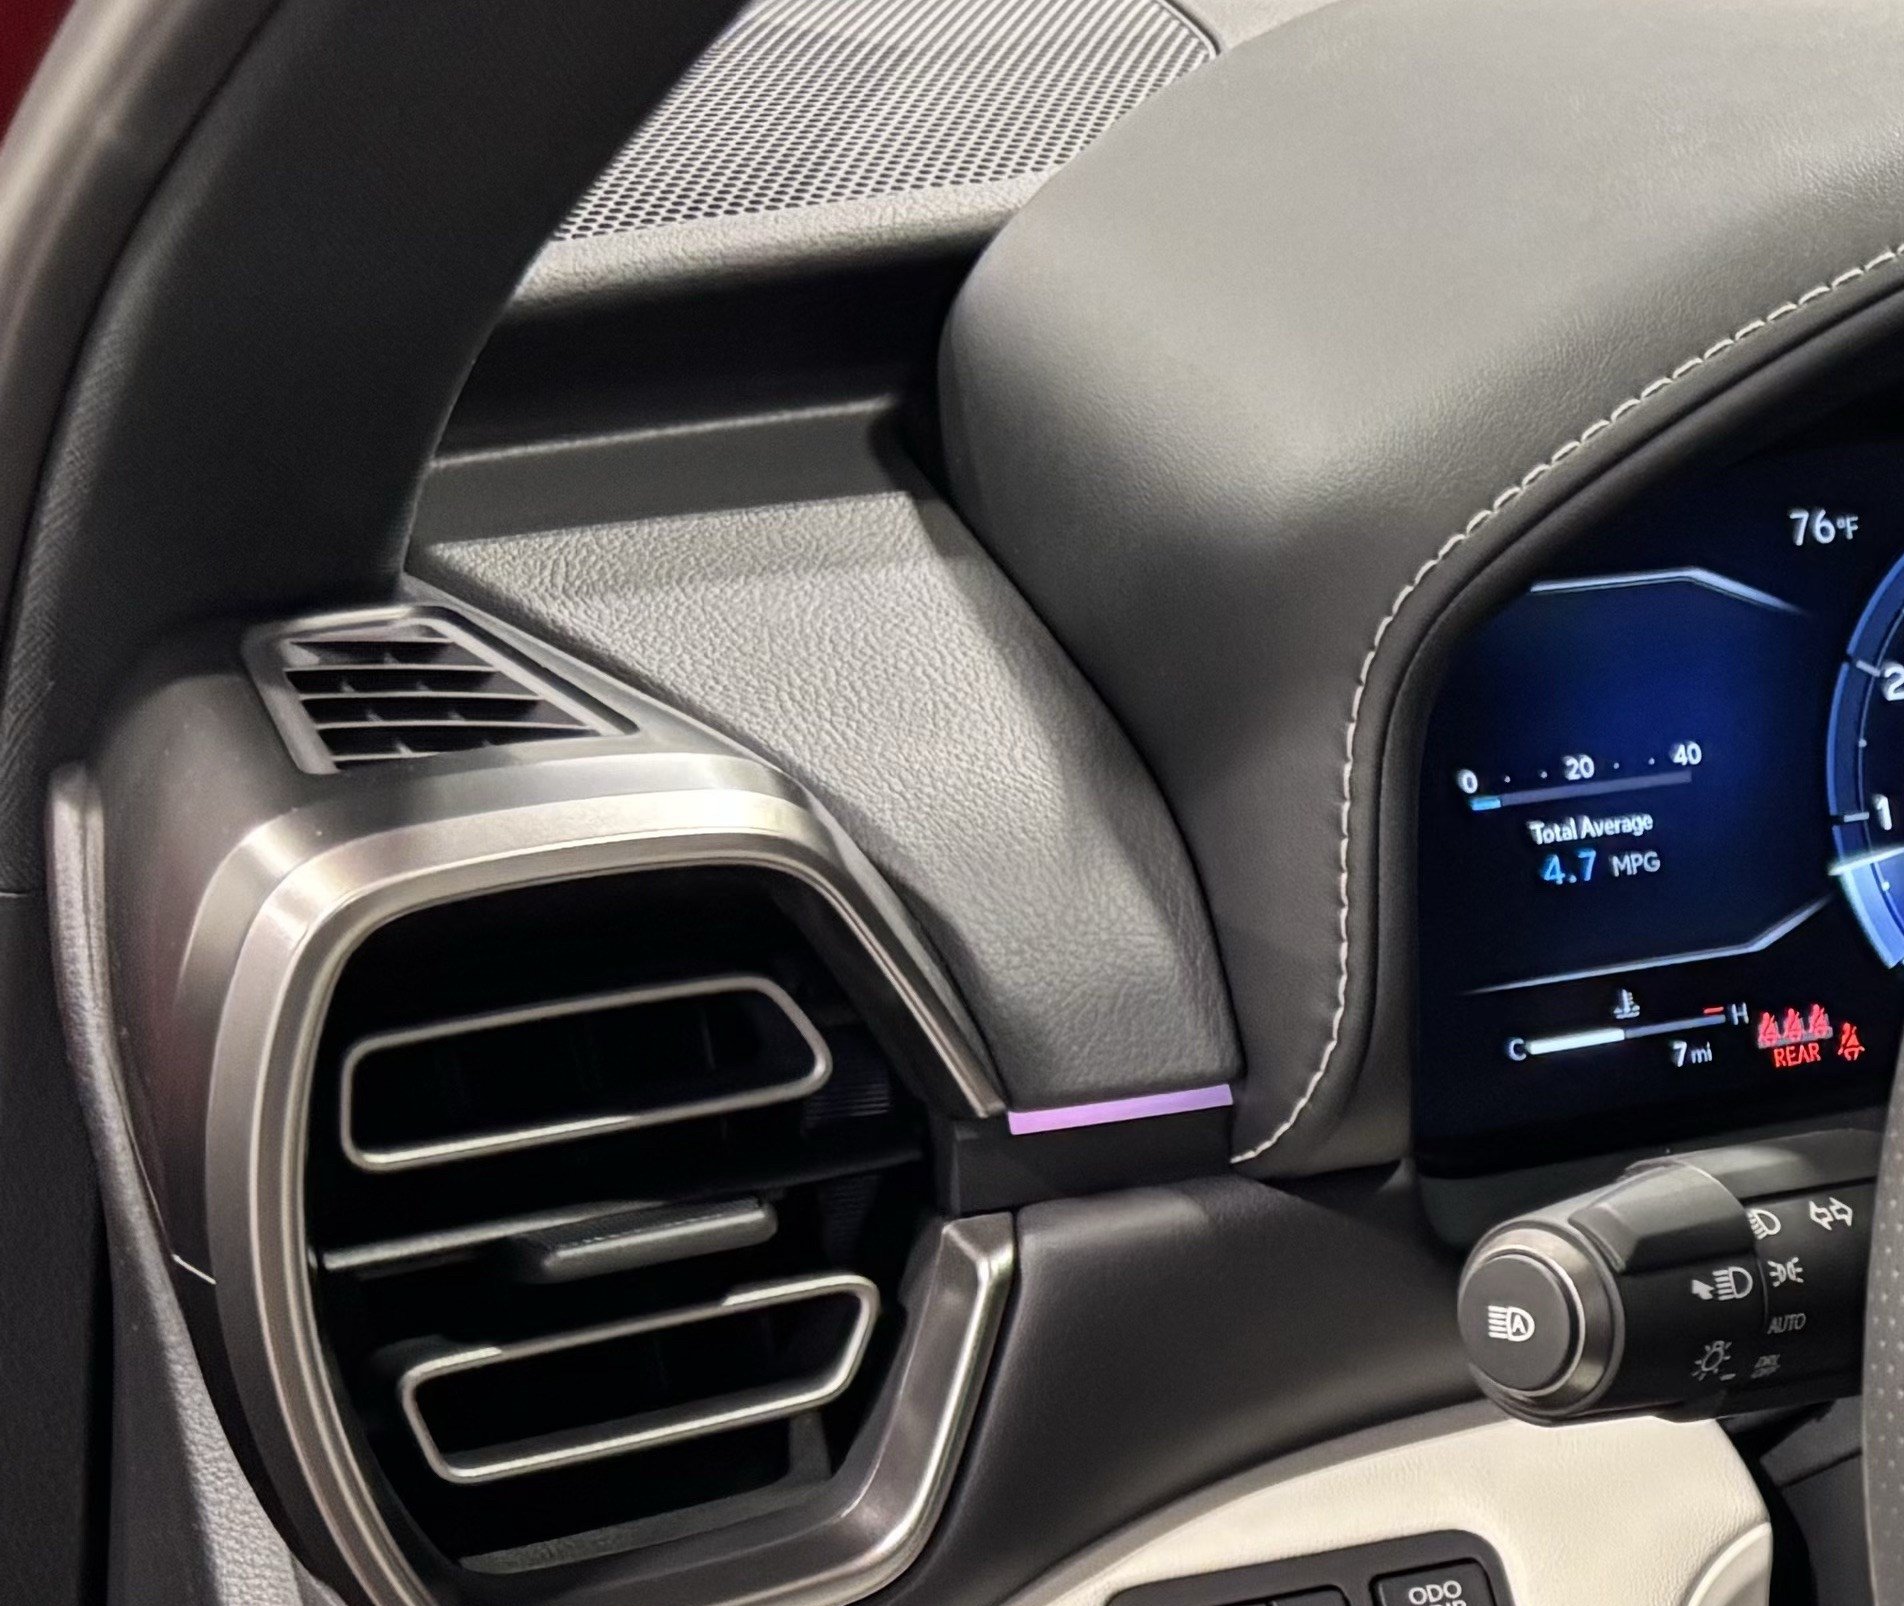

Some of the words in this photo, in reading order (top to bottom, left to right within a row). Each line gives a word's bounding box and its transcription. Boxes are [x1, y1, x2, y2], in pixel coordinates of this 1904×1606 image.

[1789, 509, 1859, 546] 76°F
[1457, 769, 1479, 795] 0
[1563, 754, 1595, 780] 20
[1671, 742, 1702, 766] 40
[1876, 795, 1893, 829] 1
[1528, 819, 1578, 846] Total
[1581, 811, 1654, 841] Average
[1541, 848, 1597, 886] 4.7
[1611, 851, 1661, 878] MPG
[1730, 1003, 1749, 1026] H
[1508, 1039, 1527, 1062] C
[1672, 1041, 1688, 1067] 7
[1690, 1044, 1713, 1065] mi
[1773, 1043, 1821, 1068] REAR
[1767, 1312, 1807, 1335] AUTO
[1408, 1579, 1462, 1606] ODO
